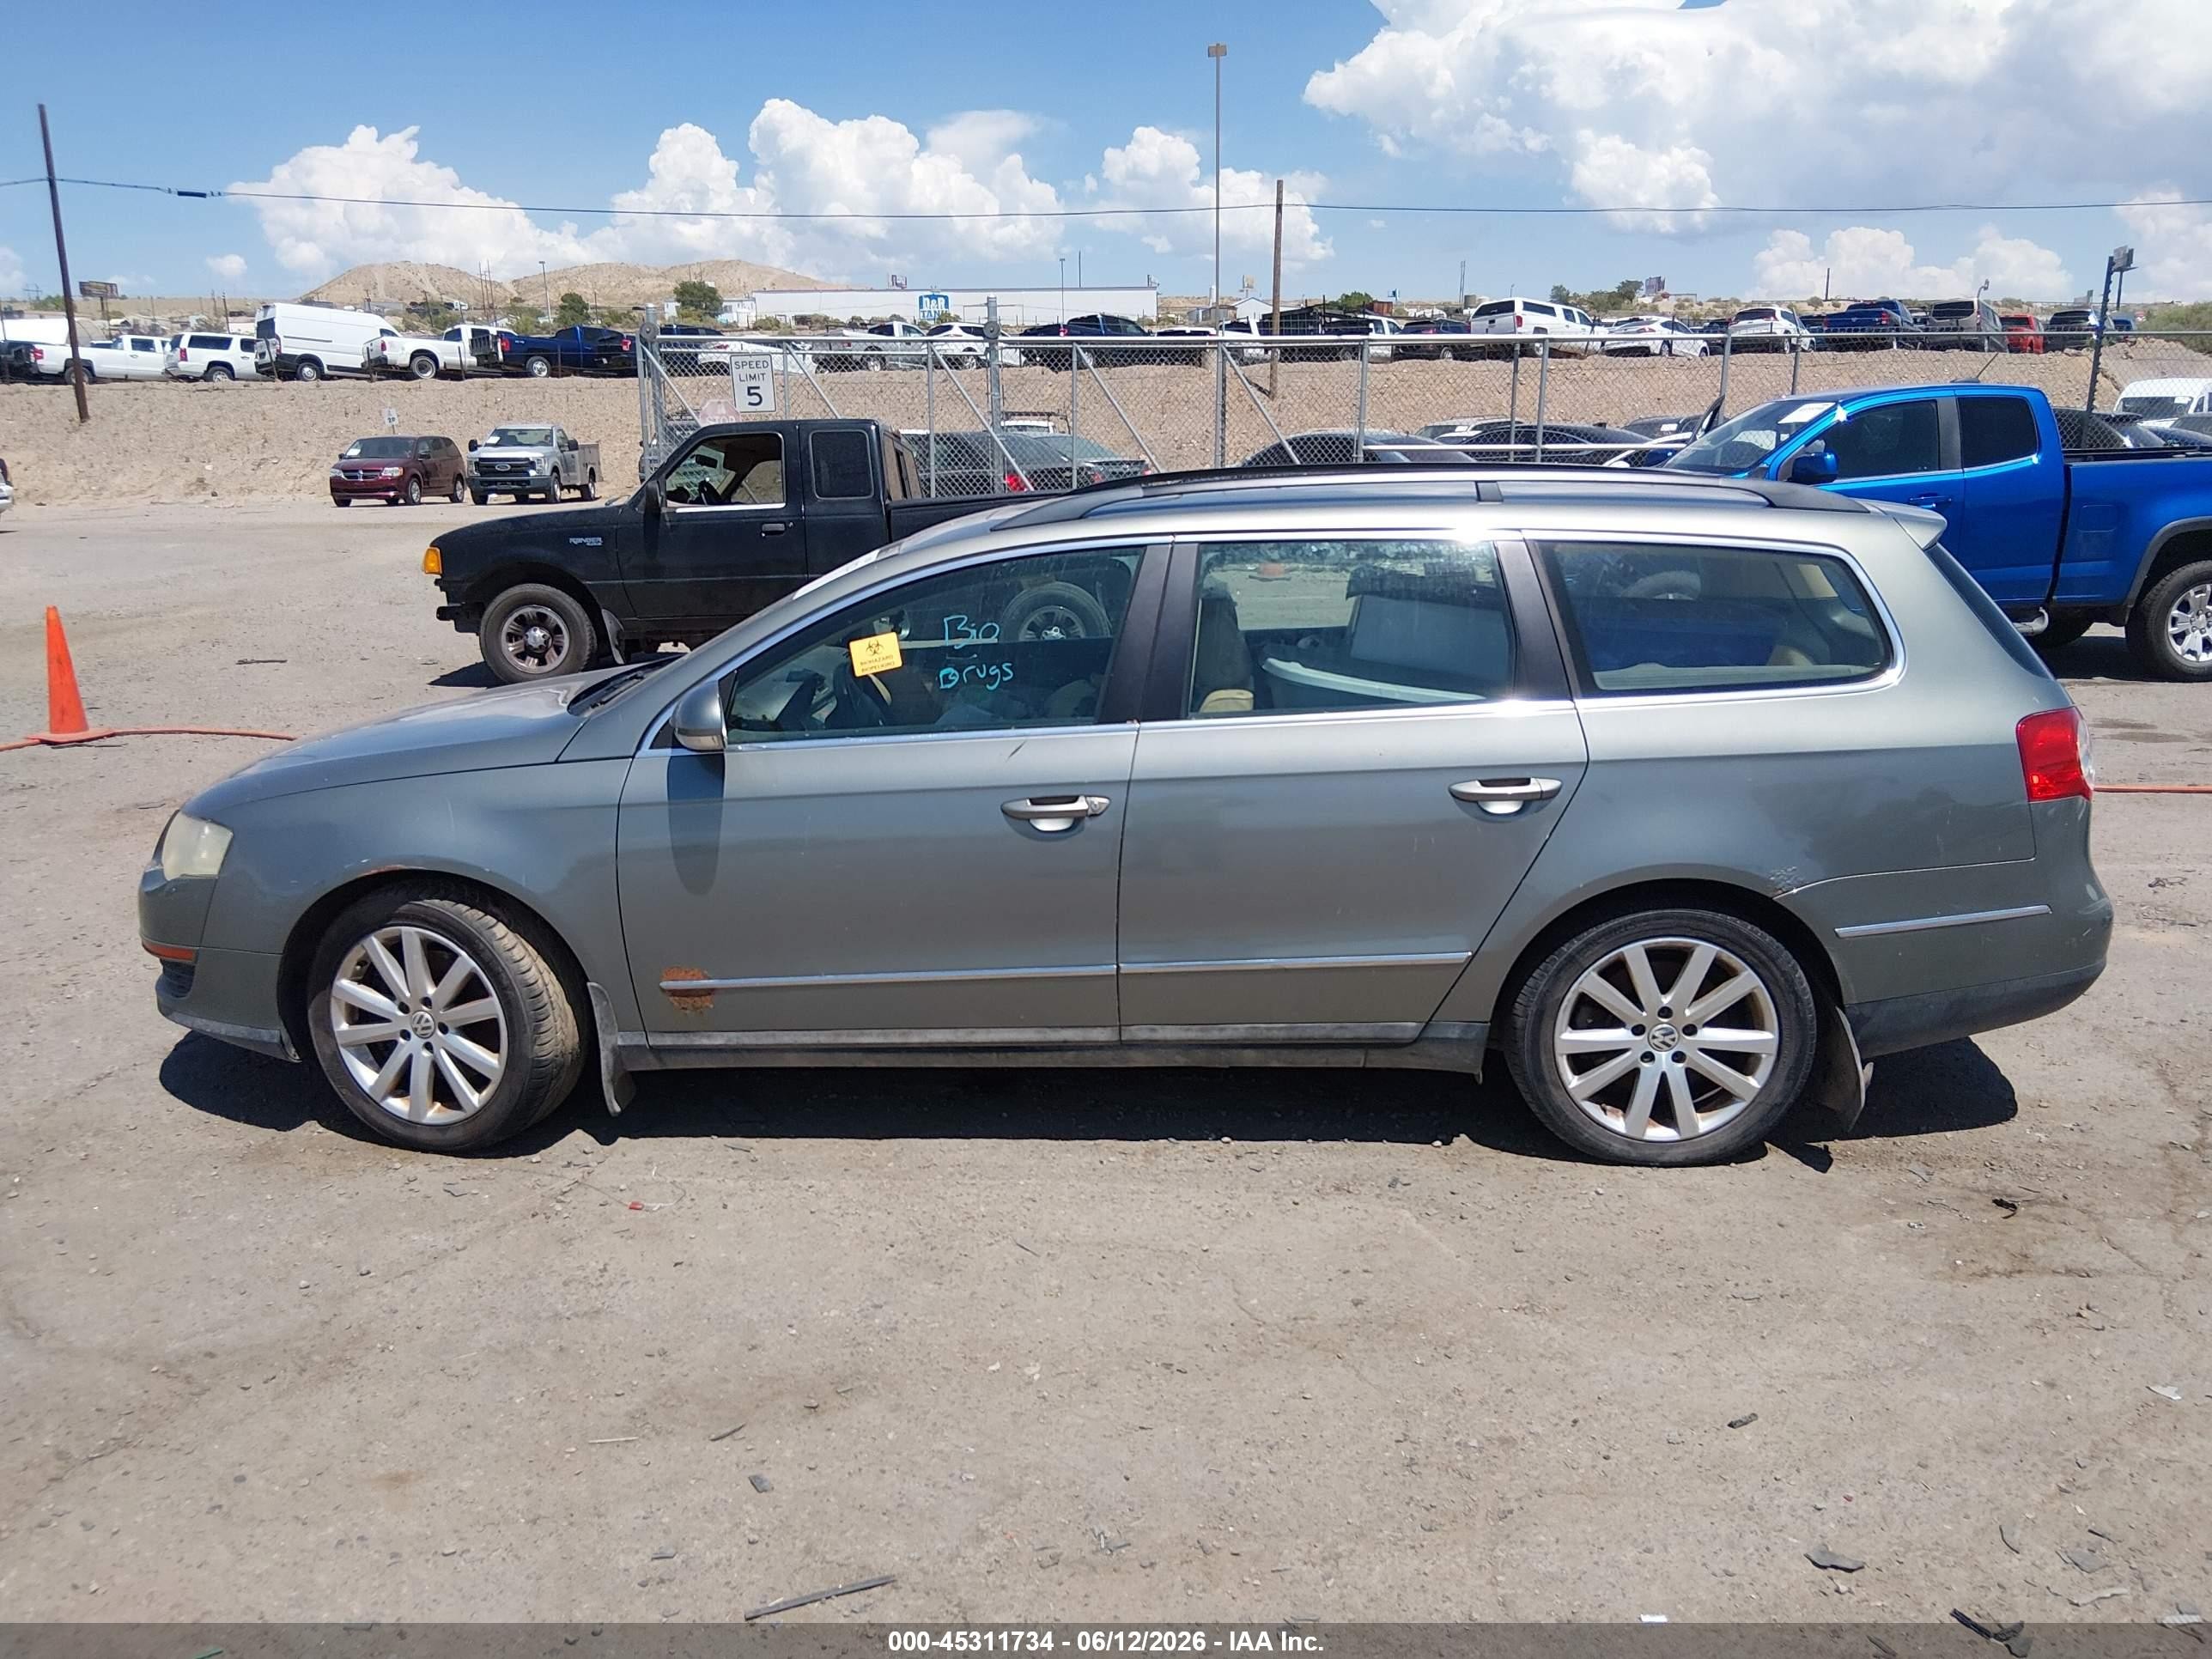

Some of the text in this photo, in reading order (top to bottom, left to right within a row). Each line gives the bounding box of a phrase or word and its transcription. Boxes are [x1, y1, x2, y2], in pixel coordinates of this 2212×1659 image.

[734, 360, 769, 370] SPEED
[738, 373, 767, 383] LIMIT
[747, 386, 763, 406] 5
[943, 614, 1000, 650] Bio
